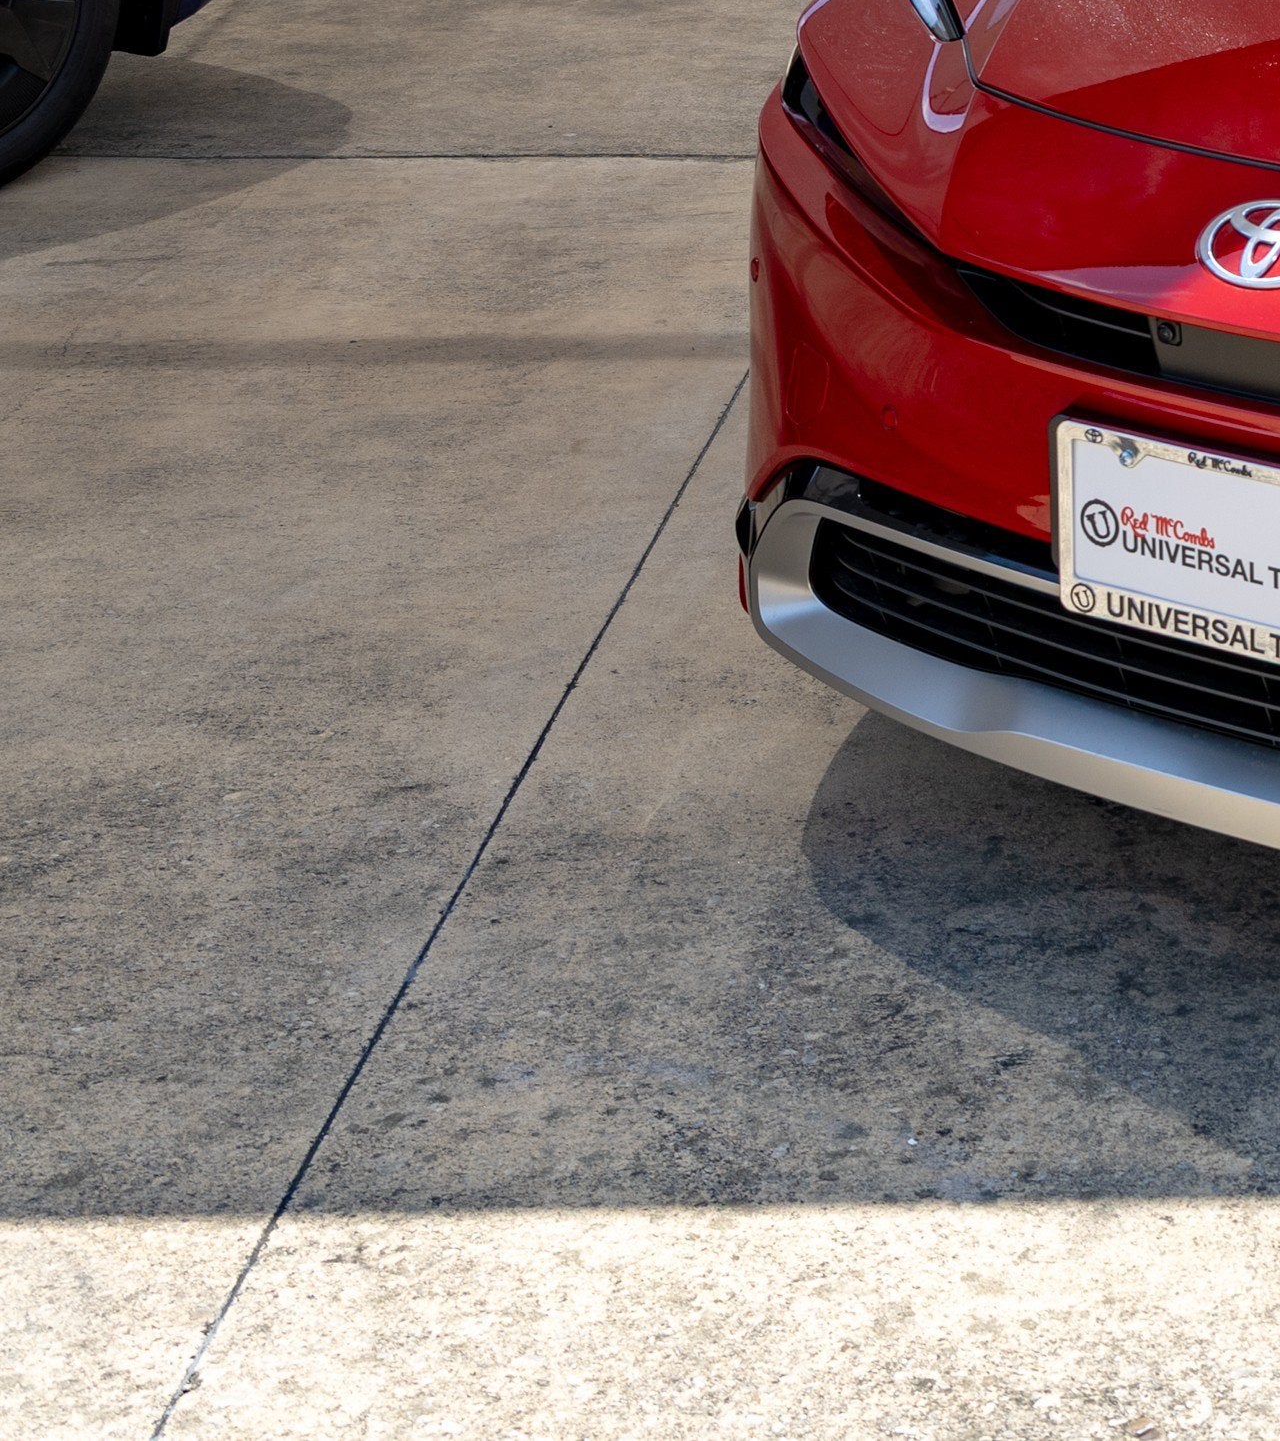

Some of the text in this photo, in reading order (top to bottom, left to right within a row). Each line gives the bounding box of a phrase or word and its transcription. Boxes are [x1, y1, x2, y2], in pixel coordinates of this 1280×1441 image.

[1120, 506, 1216, 549] Red McCombs
[1122, 529, 1264, 585] UNIVERSAL
[1106, 591, 1266, 654] UNIVERSAL
